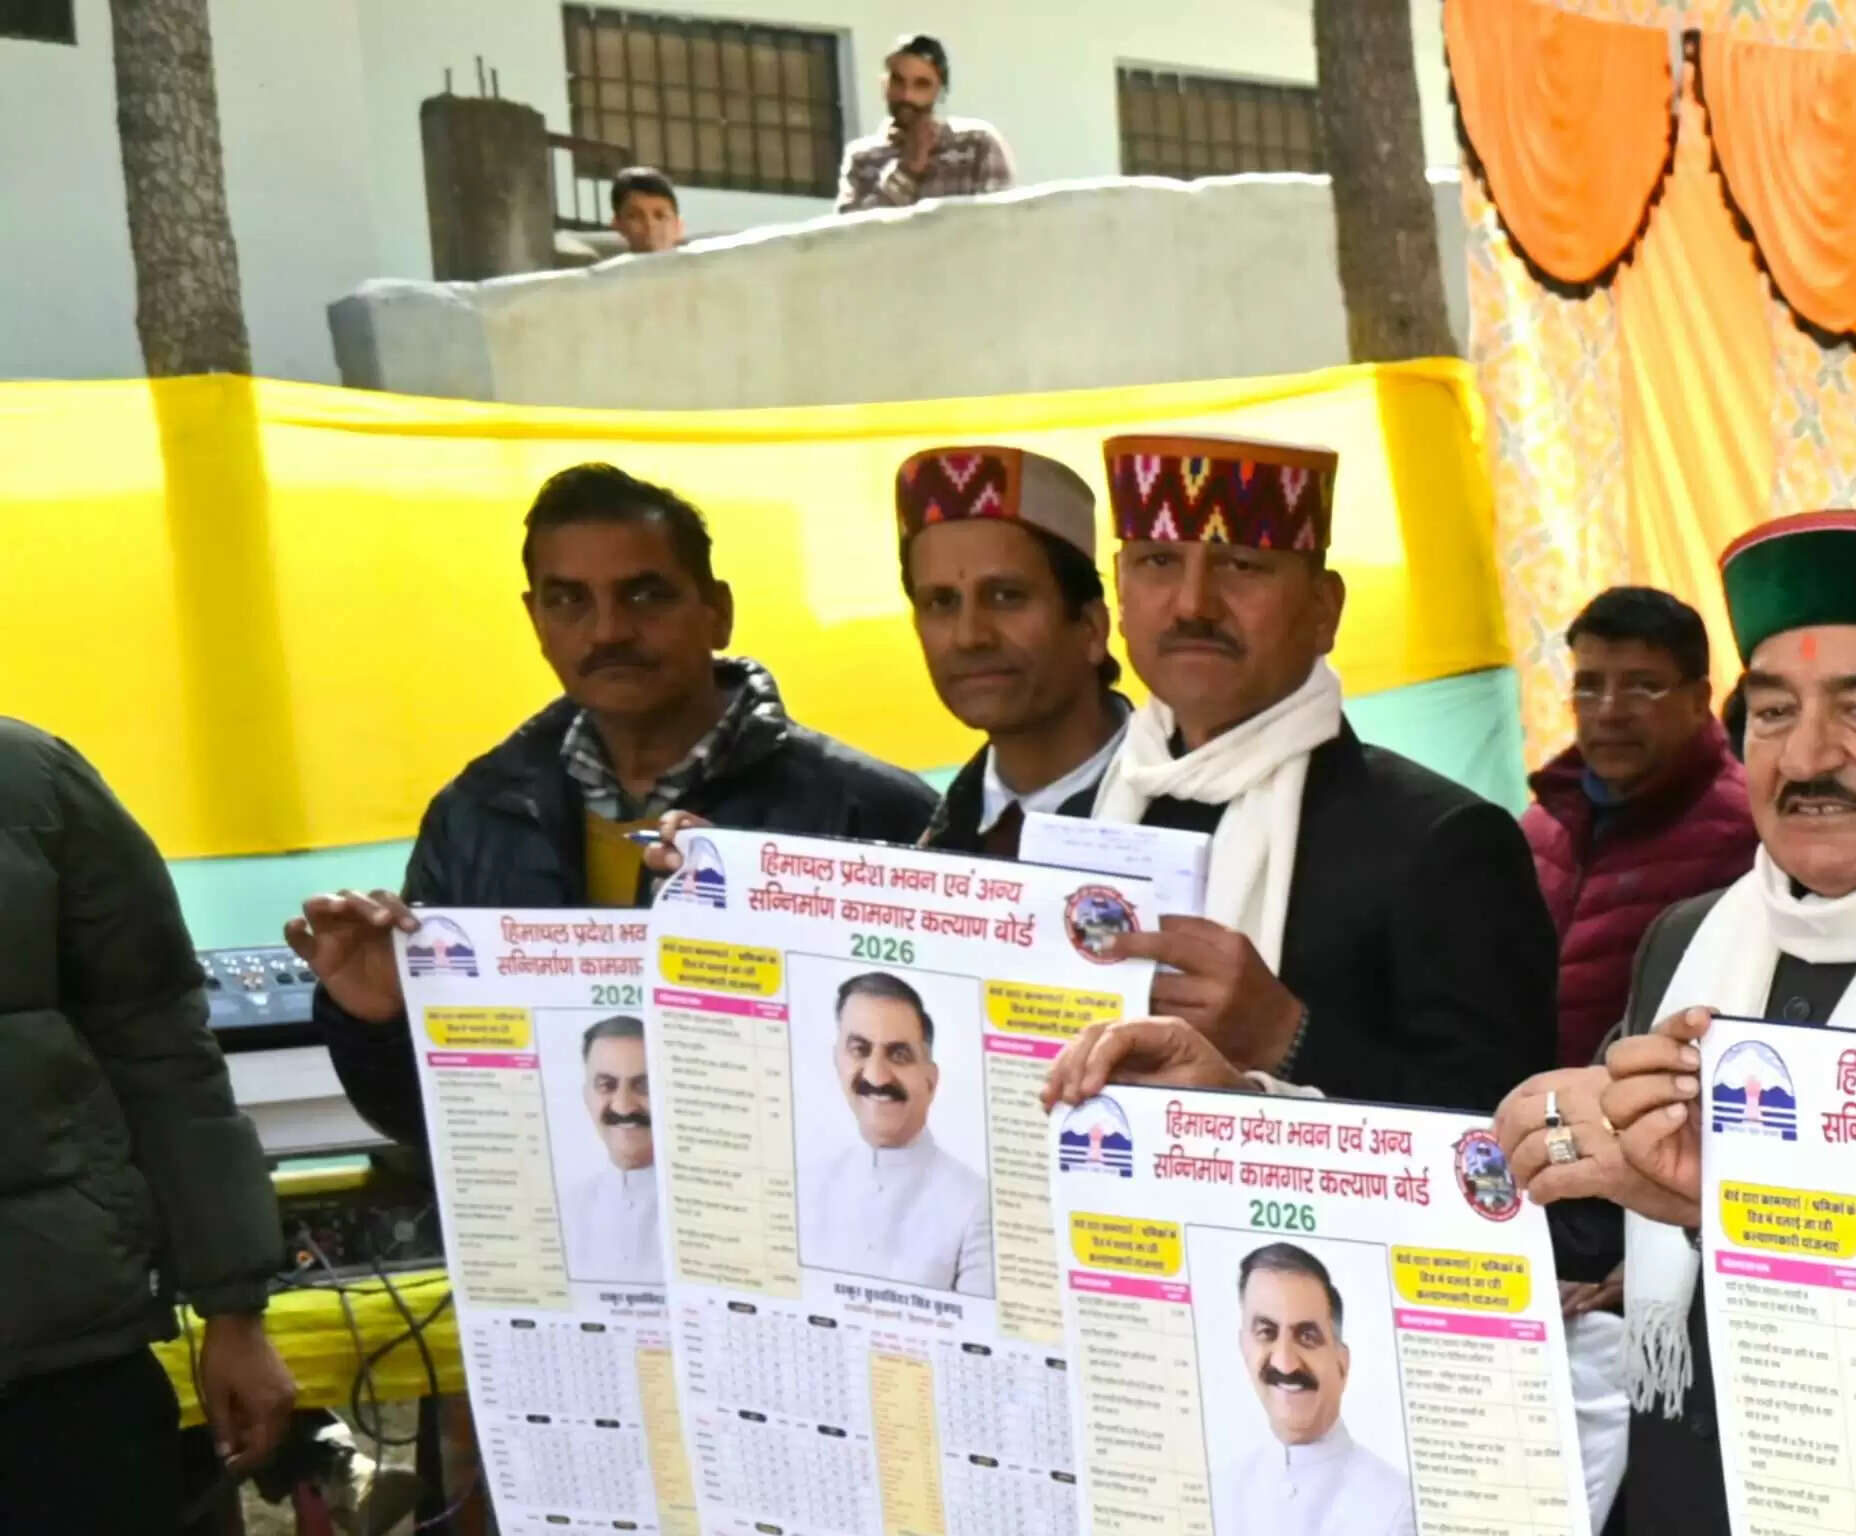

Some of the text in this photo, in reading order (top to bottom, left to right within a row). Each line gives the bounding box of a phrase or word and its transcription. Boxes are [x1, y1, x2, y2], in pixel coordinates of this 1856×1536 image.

[760, 844, 1024, 904] हिमाचल प्रदेश भवन एवं अन्य
[618, 924, 648, 944] भव
[748, 880, 836, 920] सन्निर्माण
[840, 899, 917, 931] कामगार
[920, 910, 989, 940] कल्याण
[851, 933, 915, 964] 2026
[1165, 1100, 1412, 1157] हिमाचल प्रदेश भवन एवं अन्य
[1153, 1144, 1234, 1184] सन्निर्माण
[1240, 1161, 1314, 1194] कामगार
[1318, 1169, 1388, 1200] कल्याण
[1249, 1200, 1316, 1232] 2026
